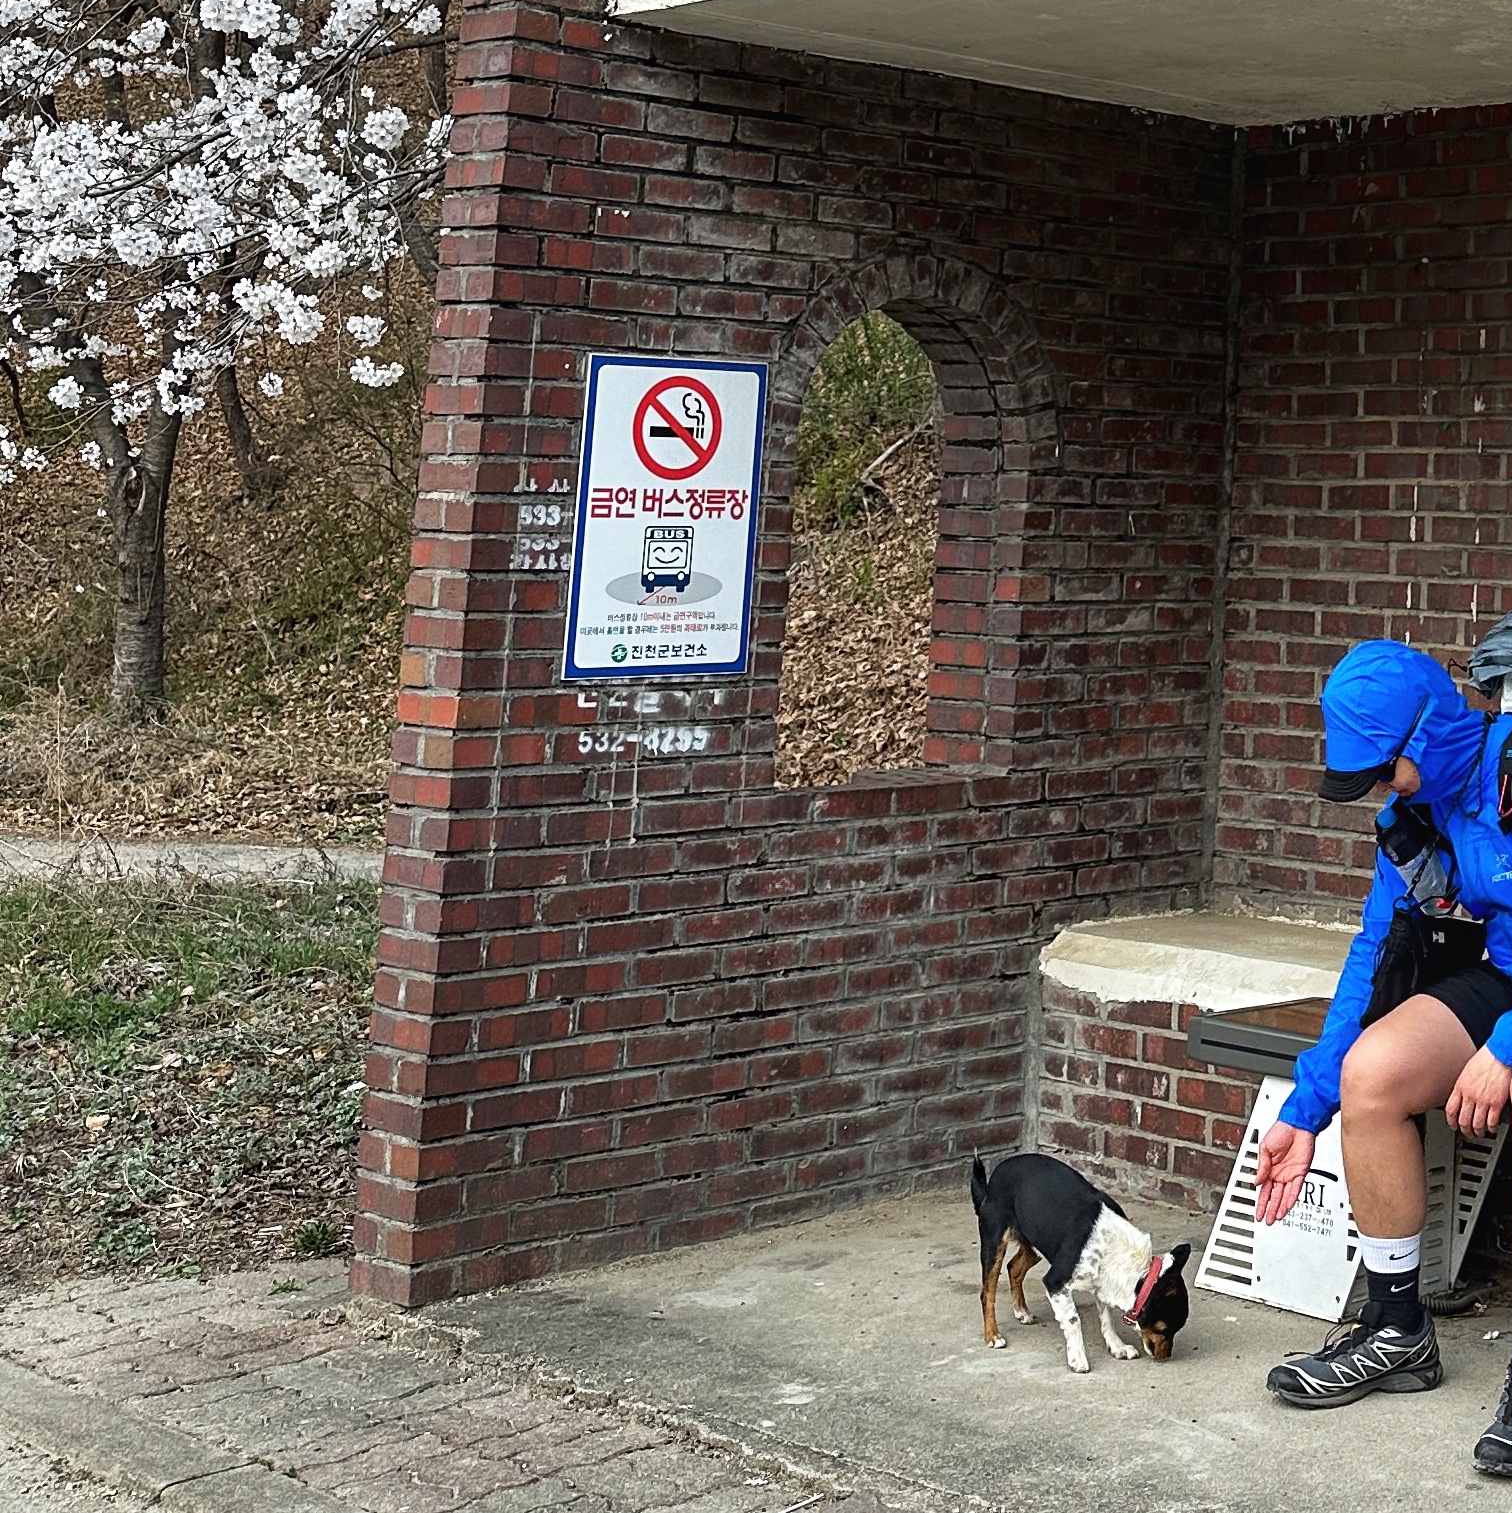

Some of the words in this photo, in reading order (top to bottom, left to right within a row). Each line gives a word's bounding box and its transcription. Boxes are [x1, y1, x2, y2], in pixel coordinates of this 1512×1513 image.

[590, 487, 637, 519] 금연
[642, 488, 748, 520] 버스정류장
[653, 529, 686, 539] BUS
[655, 595, 678, 604] 10m
[631, 643, 708, 660] 진천군보건소
